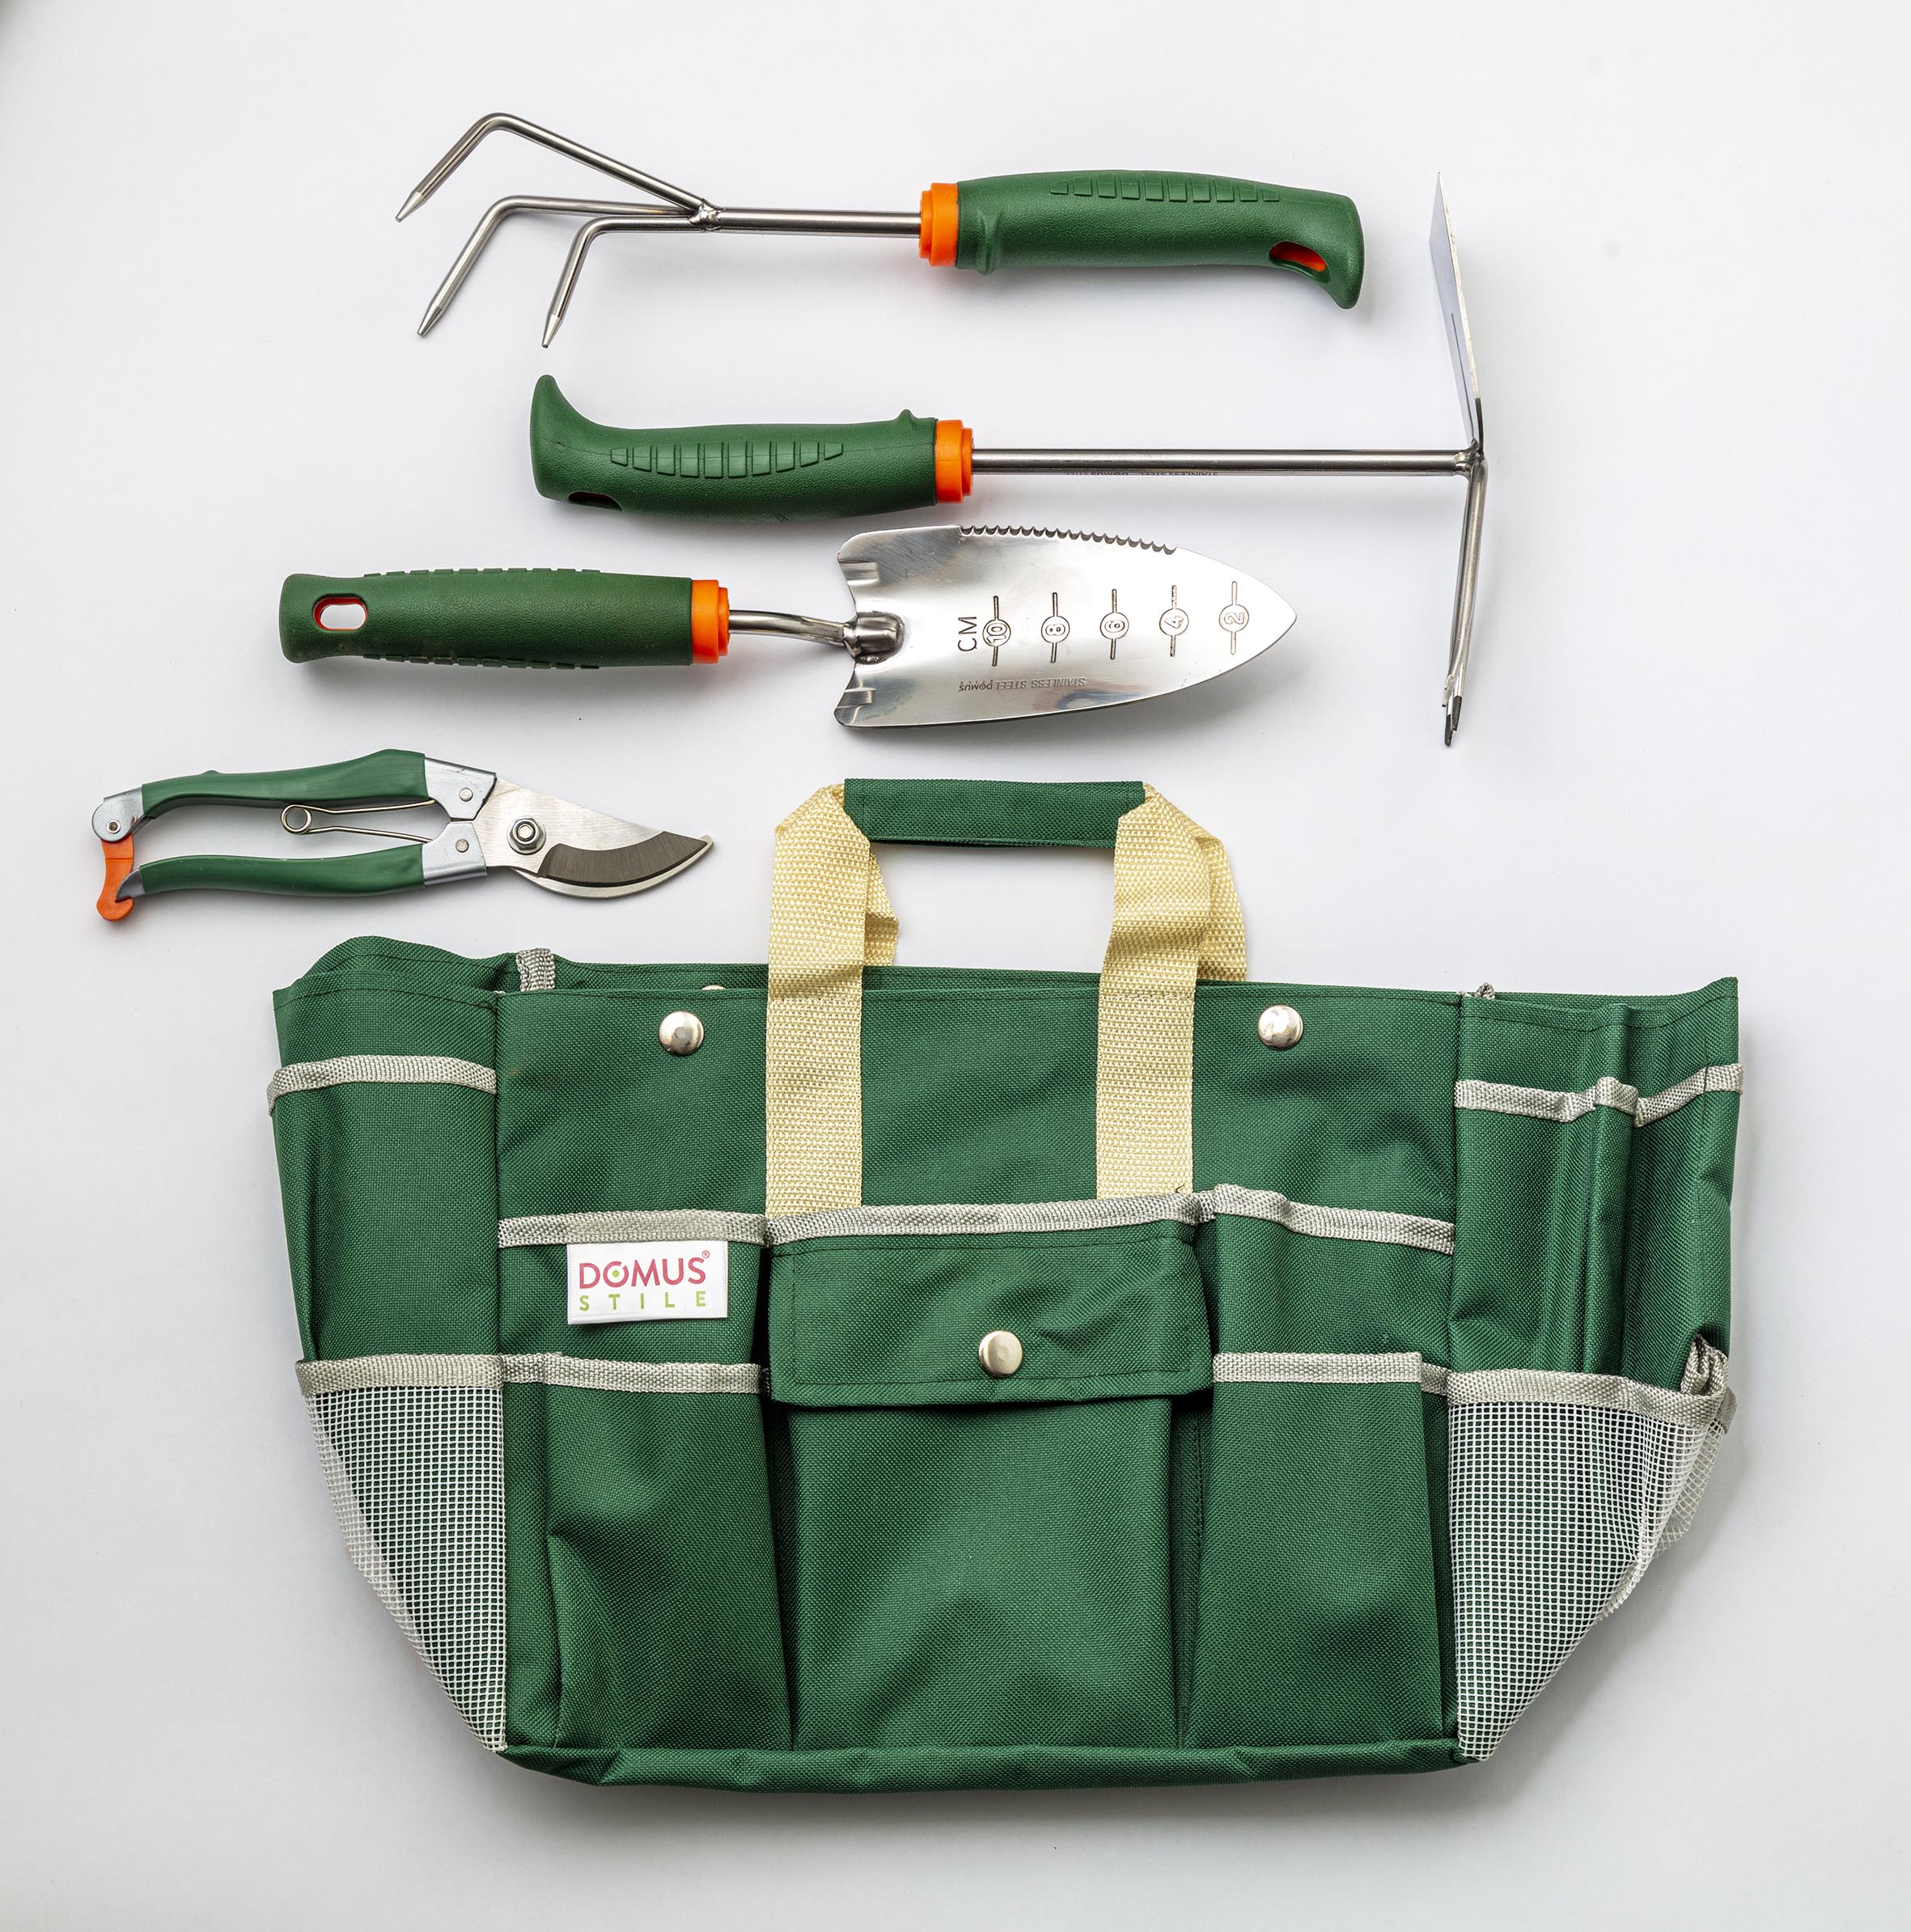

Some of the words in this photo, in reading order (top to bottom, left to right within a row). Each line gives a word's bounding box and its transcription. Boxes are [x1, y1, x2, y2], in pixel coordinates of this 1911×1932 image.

[1164, 616, 1184, 629] 4
[1224, 612, 1244, 625] 2
[986, 622, 1007, 644] 10
[1045, 623, 1066, 636] 8
[1104, 620, 1125, 633] 6
[957, 616, 977, 651] CM
[958, 683, 994, 692] DOMUS
[995, 680, 1028, 690] STEEL
[1031, 676, 1087, 688] STAINLESS
[579, 1290, 706, 1311] STILE
